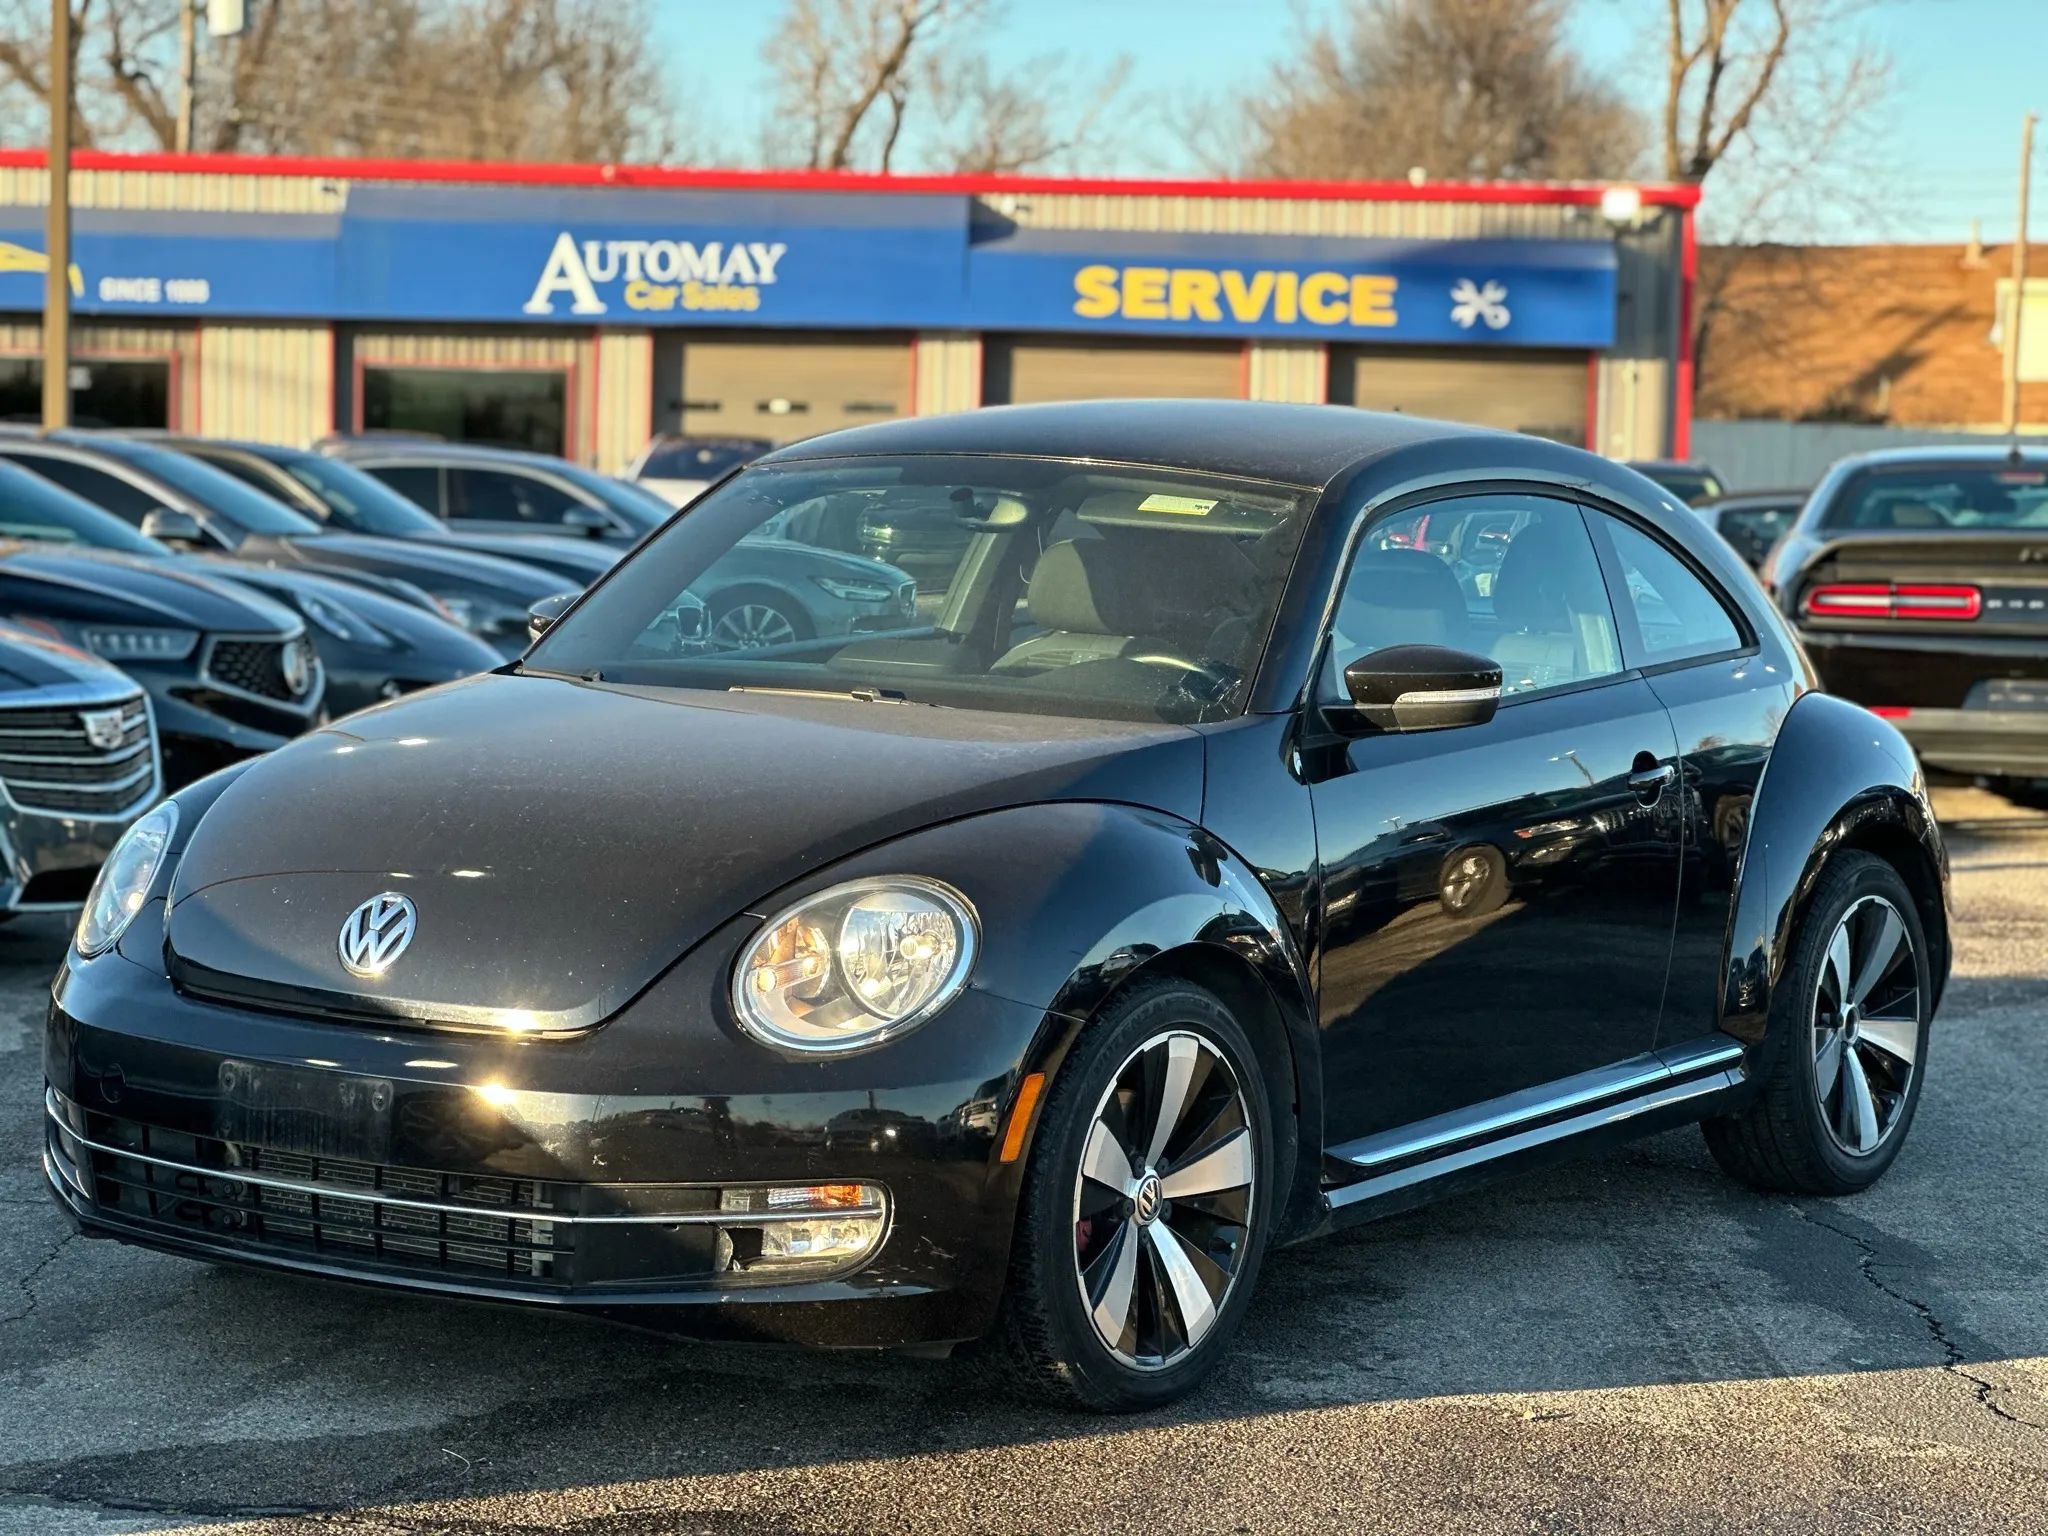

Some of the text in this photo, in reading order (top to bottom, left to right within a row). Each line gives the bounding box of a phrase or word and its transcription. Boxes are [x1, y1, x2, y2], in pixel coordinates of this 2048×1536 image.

[523, 231, 787, 315] AUTOMAY
[624, 279, 680, 311] Car
[1072, 265, 1398, 327] SERVICE
